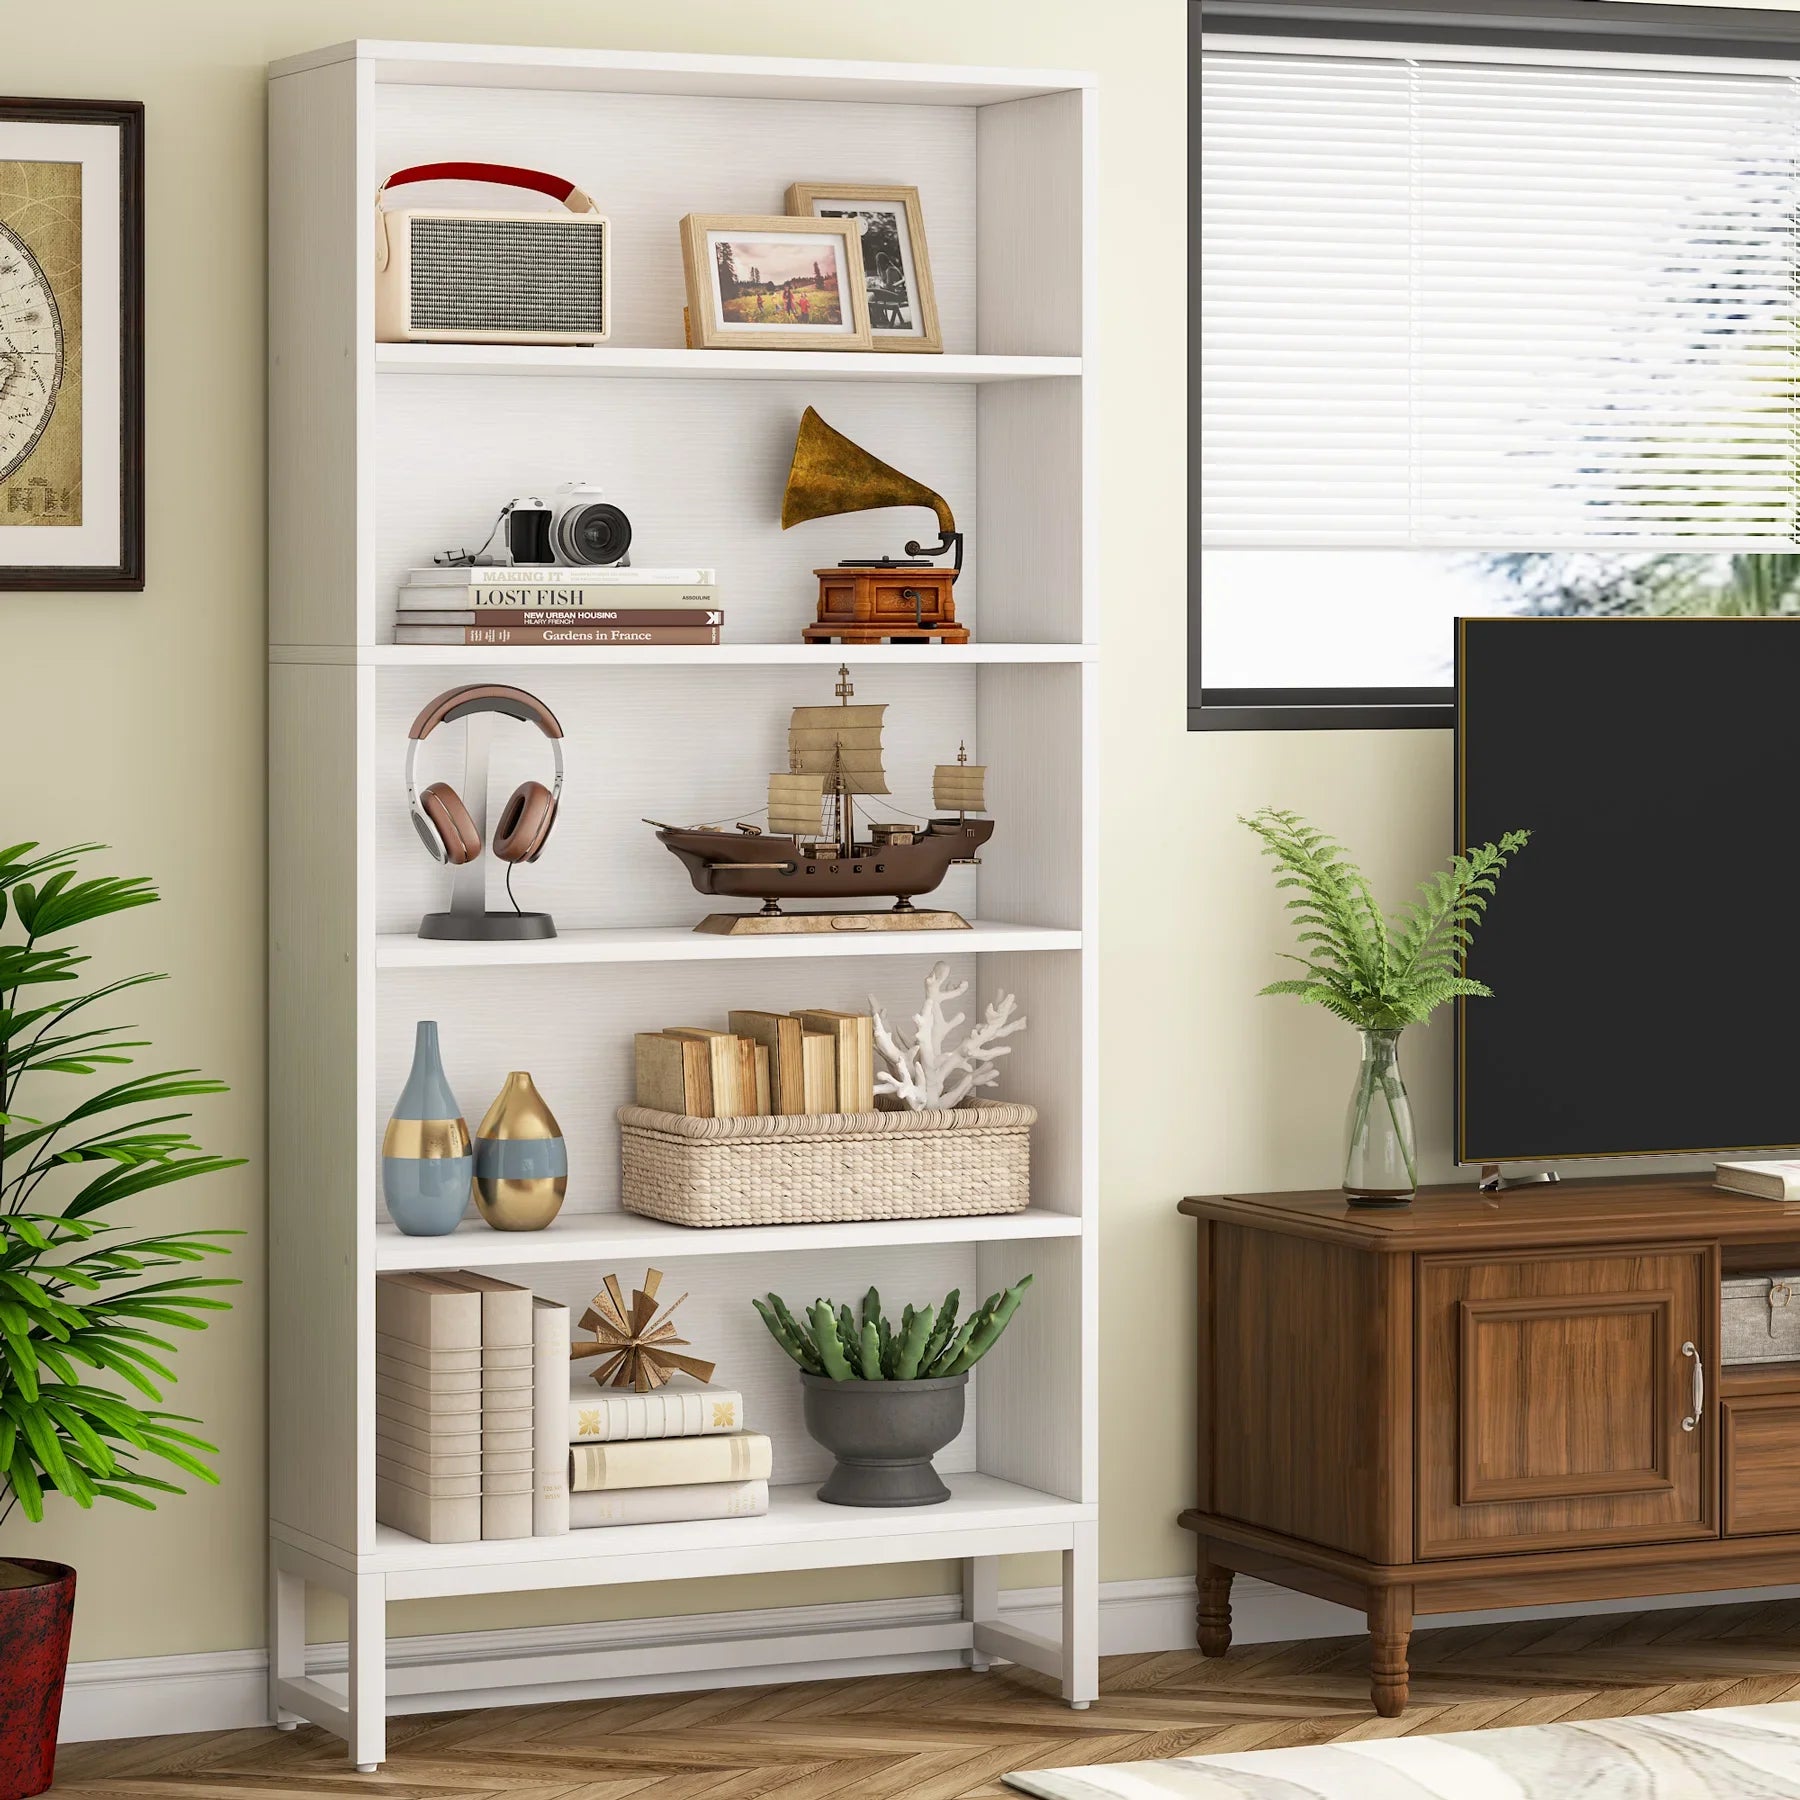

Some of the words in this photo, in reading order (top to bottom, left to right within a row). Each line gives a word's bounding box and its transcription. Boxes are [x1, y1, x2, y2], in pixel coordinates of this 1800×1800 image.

[483, 571, 544, 582] MAKING
[548, 571, 563, 582] IT
[476, 590, 531, 605] LOST
[537, 590, 583, 605] FISH
[543, 630, 593, 641] Gardens
[596, 630, 608, 641] in
[611, 630, 652, 641] France
